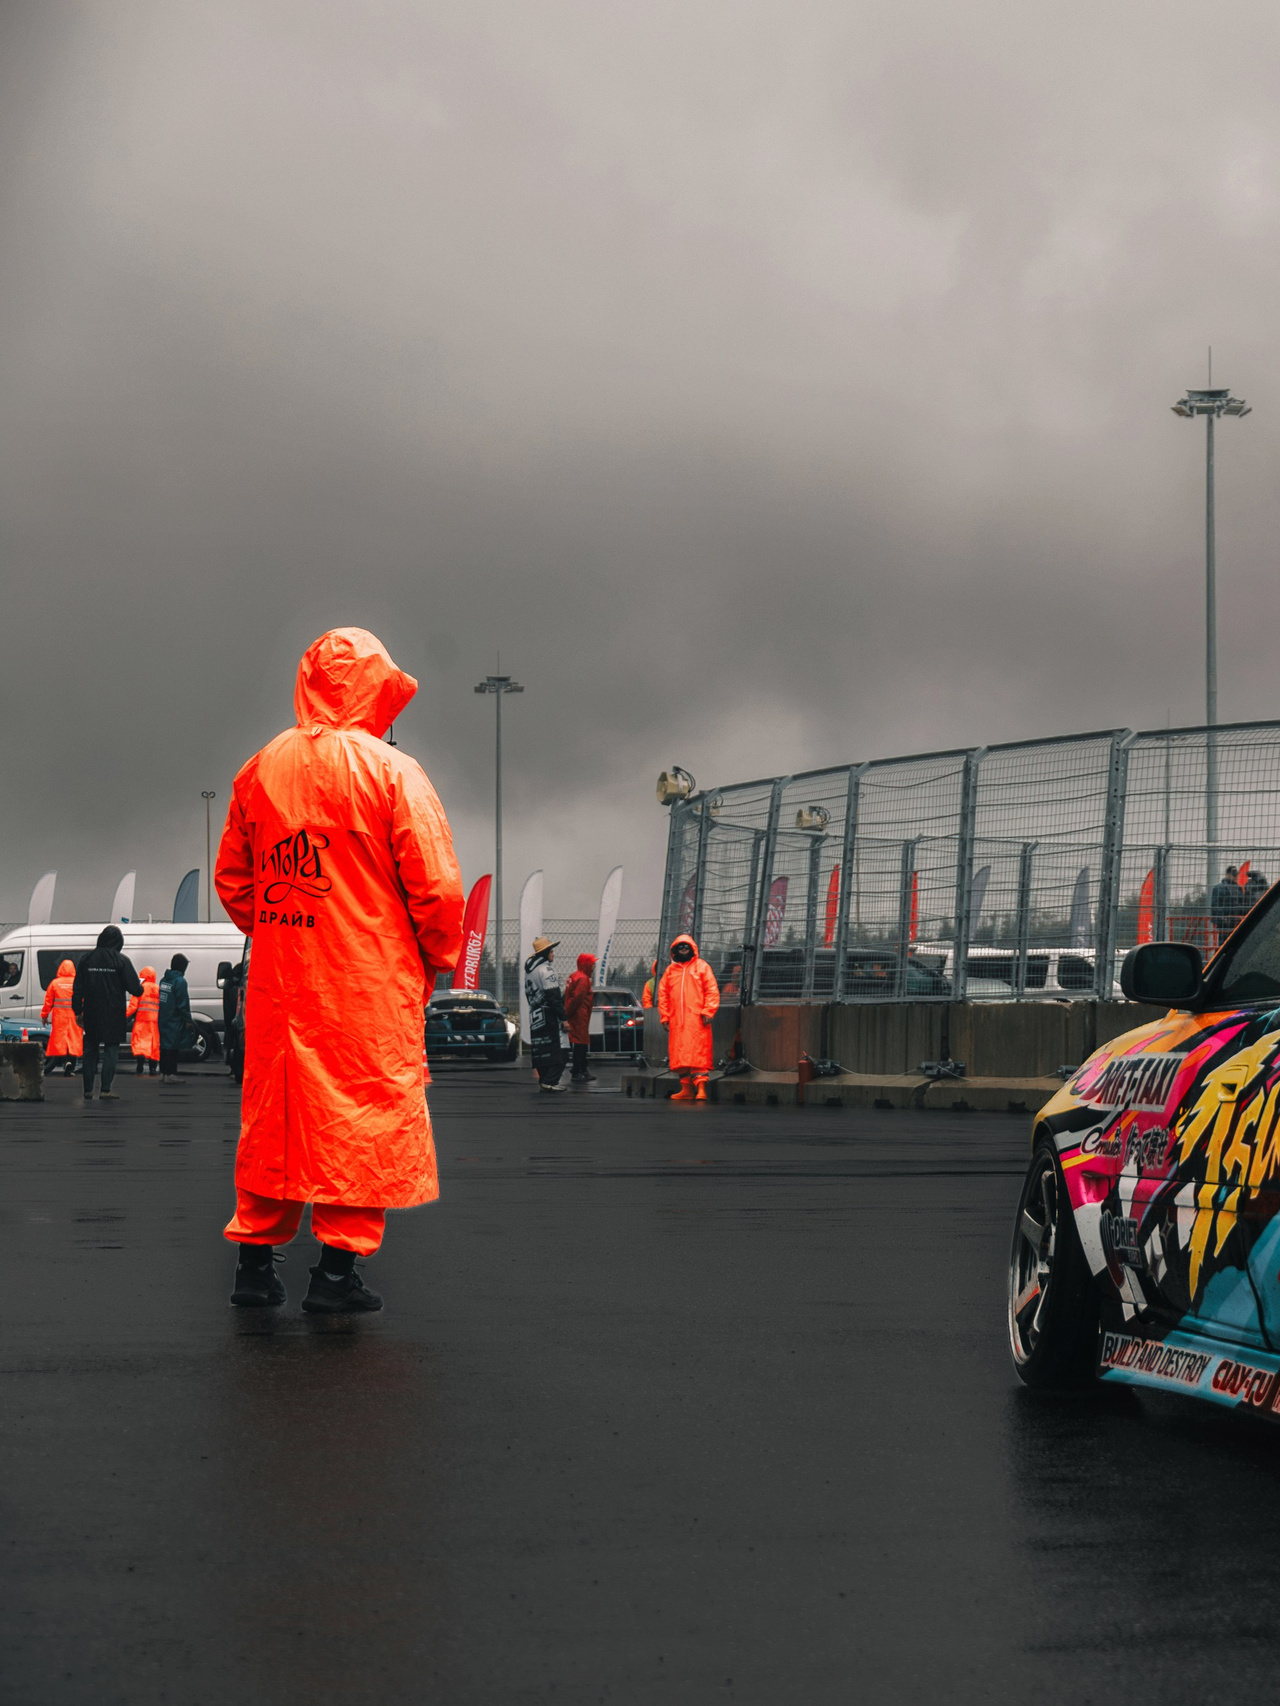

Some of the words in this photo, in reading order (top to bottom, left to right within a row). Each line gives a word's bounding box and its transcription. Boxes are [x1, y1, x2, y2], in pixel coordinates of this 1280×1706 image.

[259, 911, 315, 928] ДРАЙВ
[1102, 1334, 1142, 1368] BUILD
[1138, 1341, 1165, 1373] AND
[1156, 1347, 1212, 1384] DESTROY
